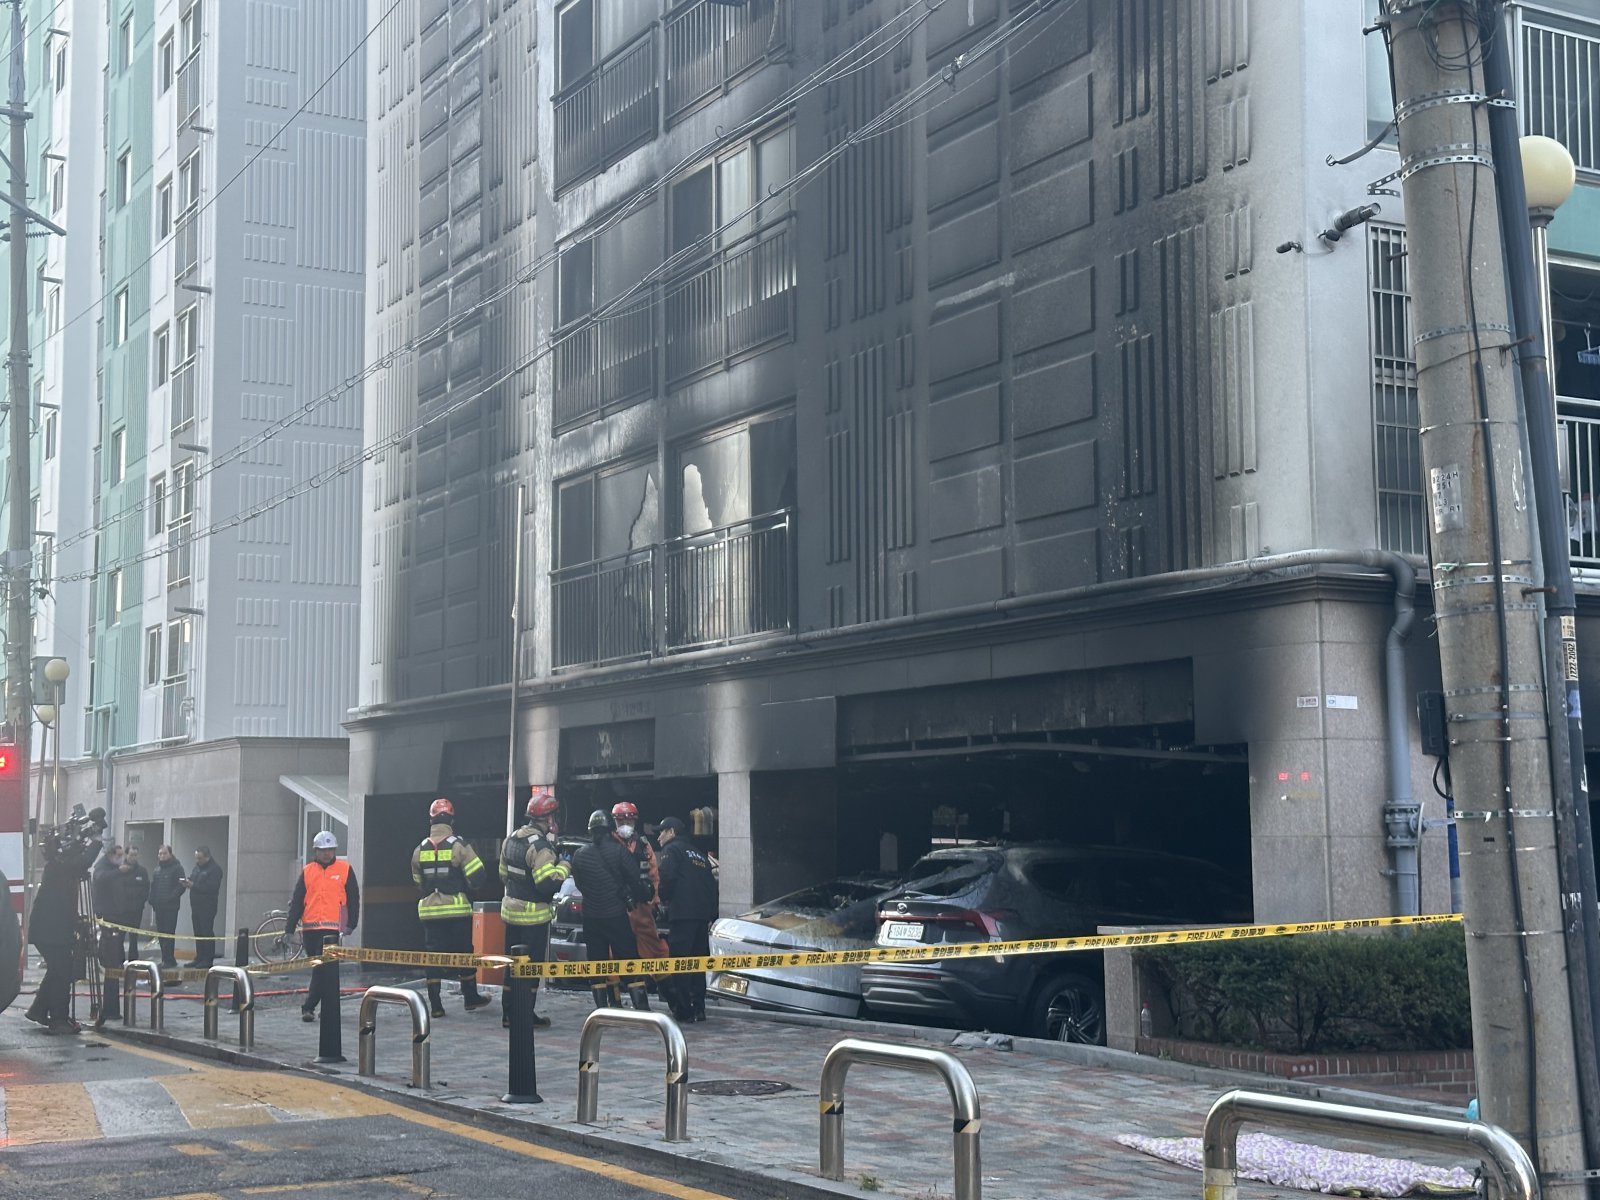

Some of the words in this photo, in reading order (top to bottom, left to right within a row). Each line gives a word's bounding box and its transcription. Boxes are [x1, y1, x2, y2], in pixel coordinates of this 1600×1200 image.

[563, 964, 577, 975] FIRE
[577, 963, 591, 974] LINE
[641, 961, 655, 973] FIRE
[655, 960, 670, 972] LINE
[721, 957, 736, 969] FIRE
[736, 957, 751, 968] LINE
[806, 954, 822, 964] FIRE
[822, 953, 837, 963] LINE
[893, 949, 910, 960] FIRE
[910, 948, 927, 959] LINE
[986, 944, 1003, 954] FIRE
[1003, 943, 1021, 953] LINE
[1083, 938, 1102, 947] FIRE
[1102, 937, 1120, 946] LINE
[1185, 931, 1205, 941] FIRE
[1205, 930, 1224, 940] LINE
